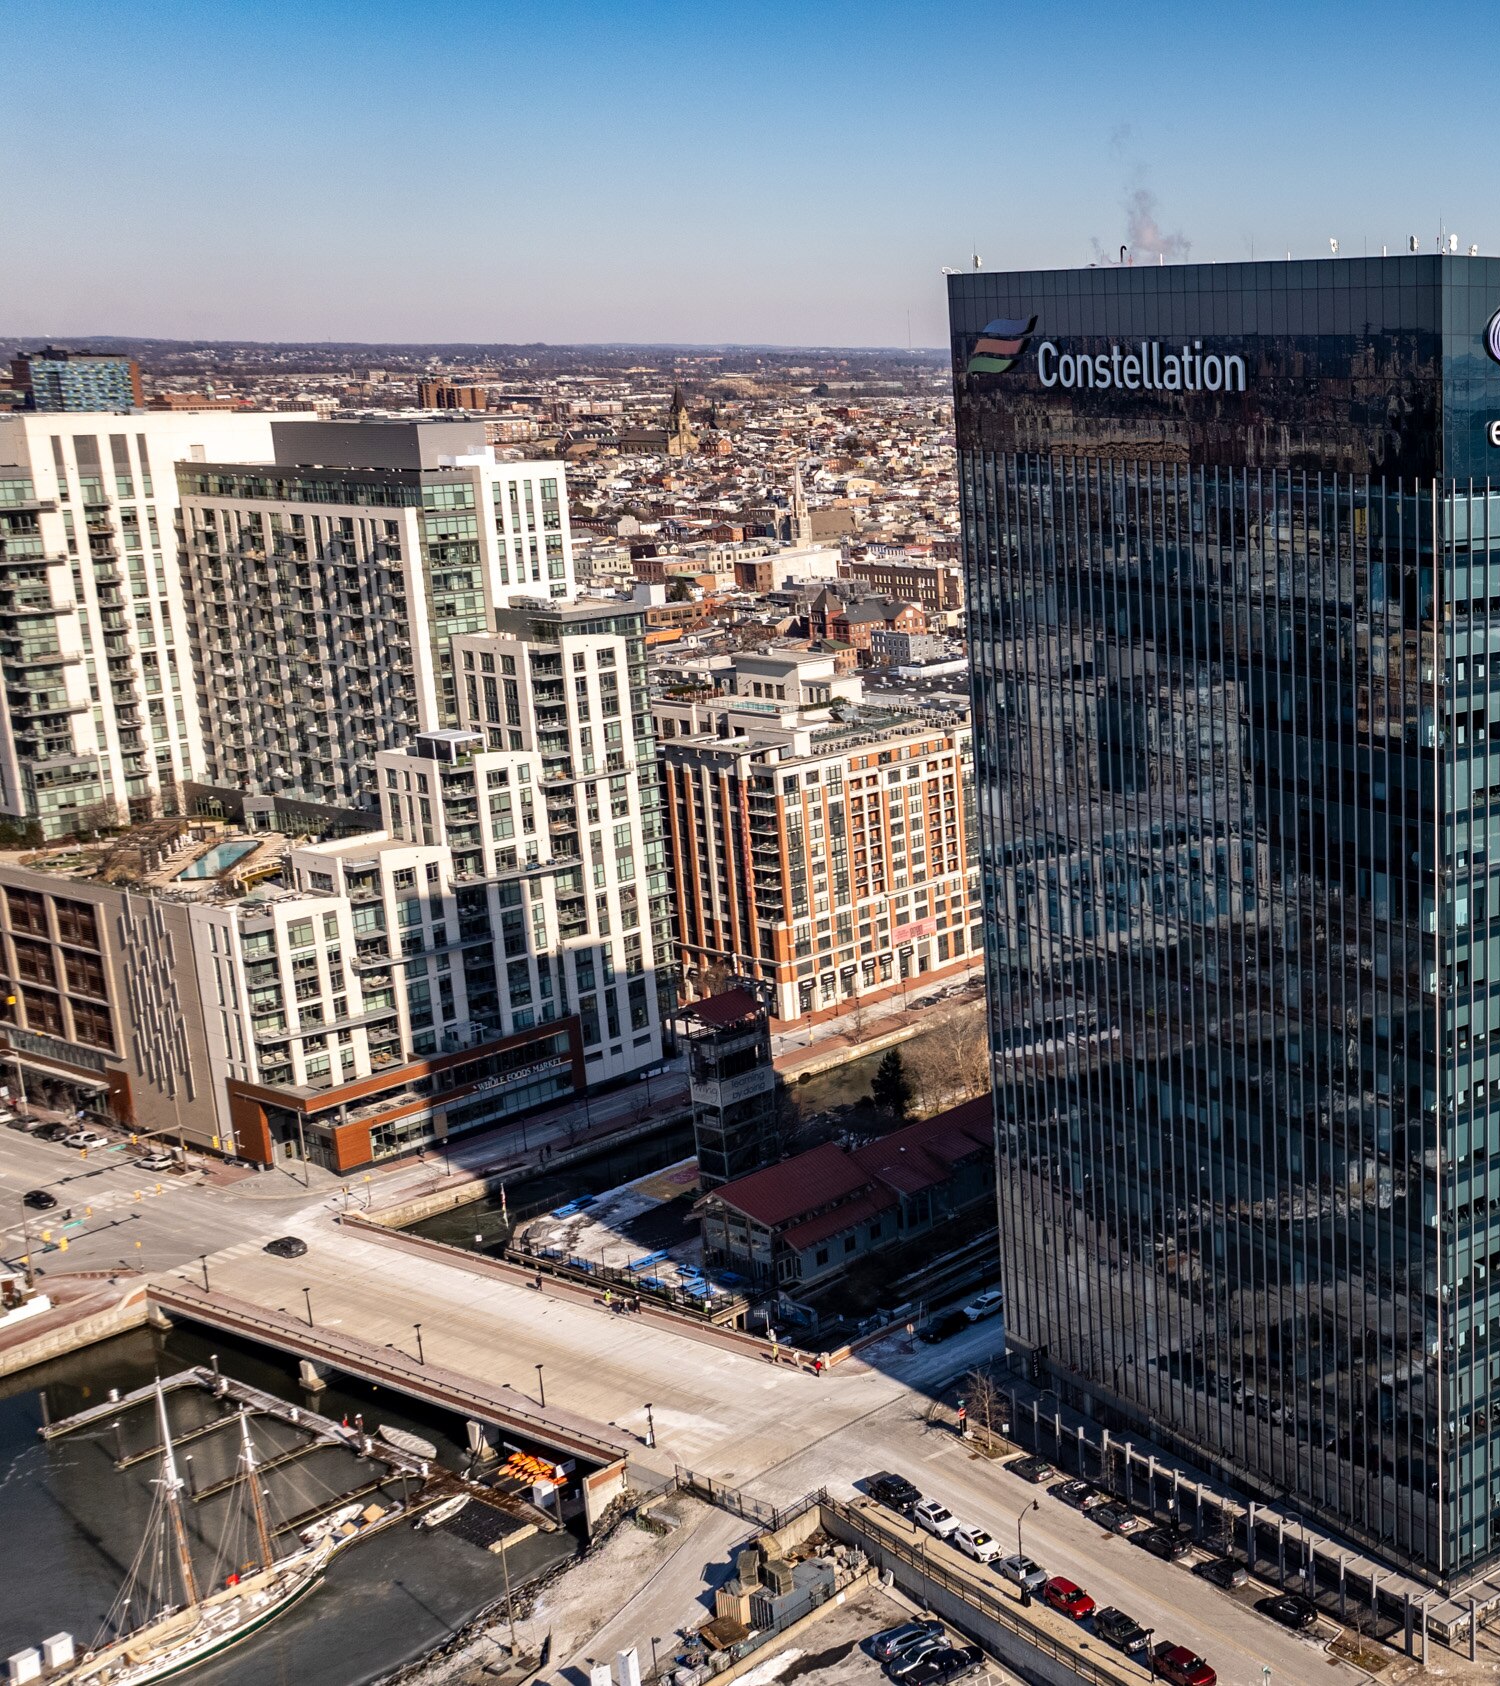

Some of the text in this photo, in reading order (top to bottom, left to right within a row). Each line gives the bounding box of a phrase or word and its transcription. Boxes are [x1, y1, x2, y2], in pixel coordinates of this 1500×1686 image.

[1038, 341, 1246, 392] Constellation
[476, 1057, 562, 1092] WHOLE FOODS MARKET
[732, 1071, 766, 1089] learning
[732, 1082, 767, 1100] by doing
